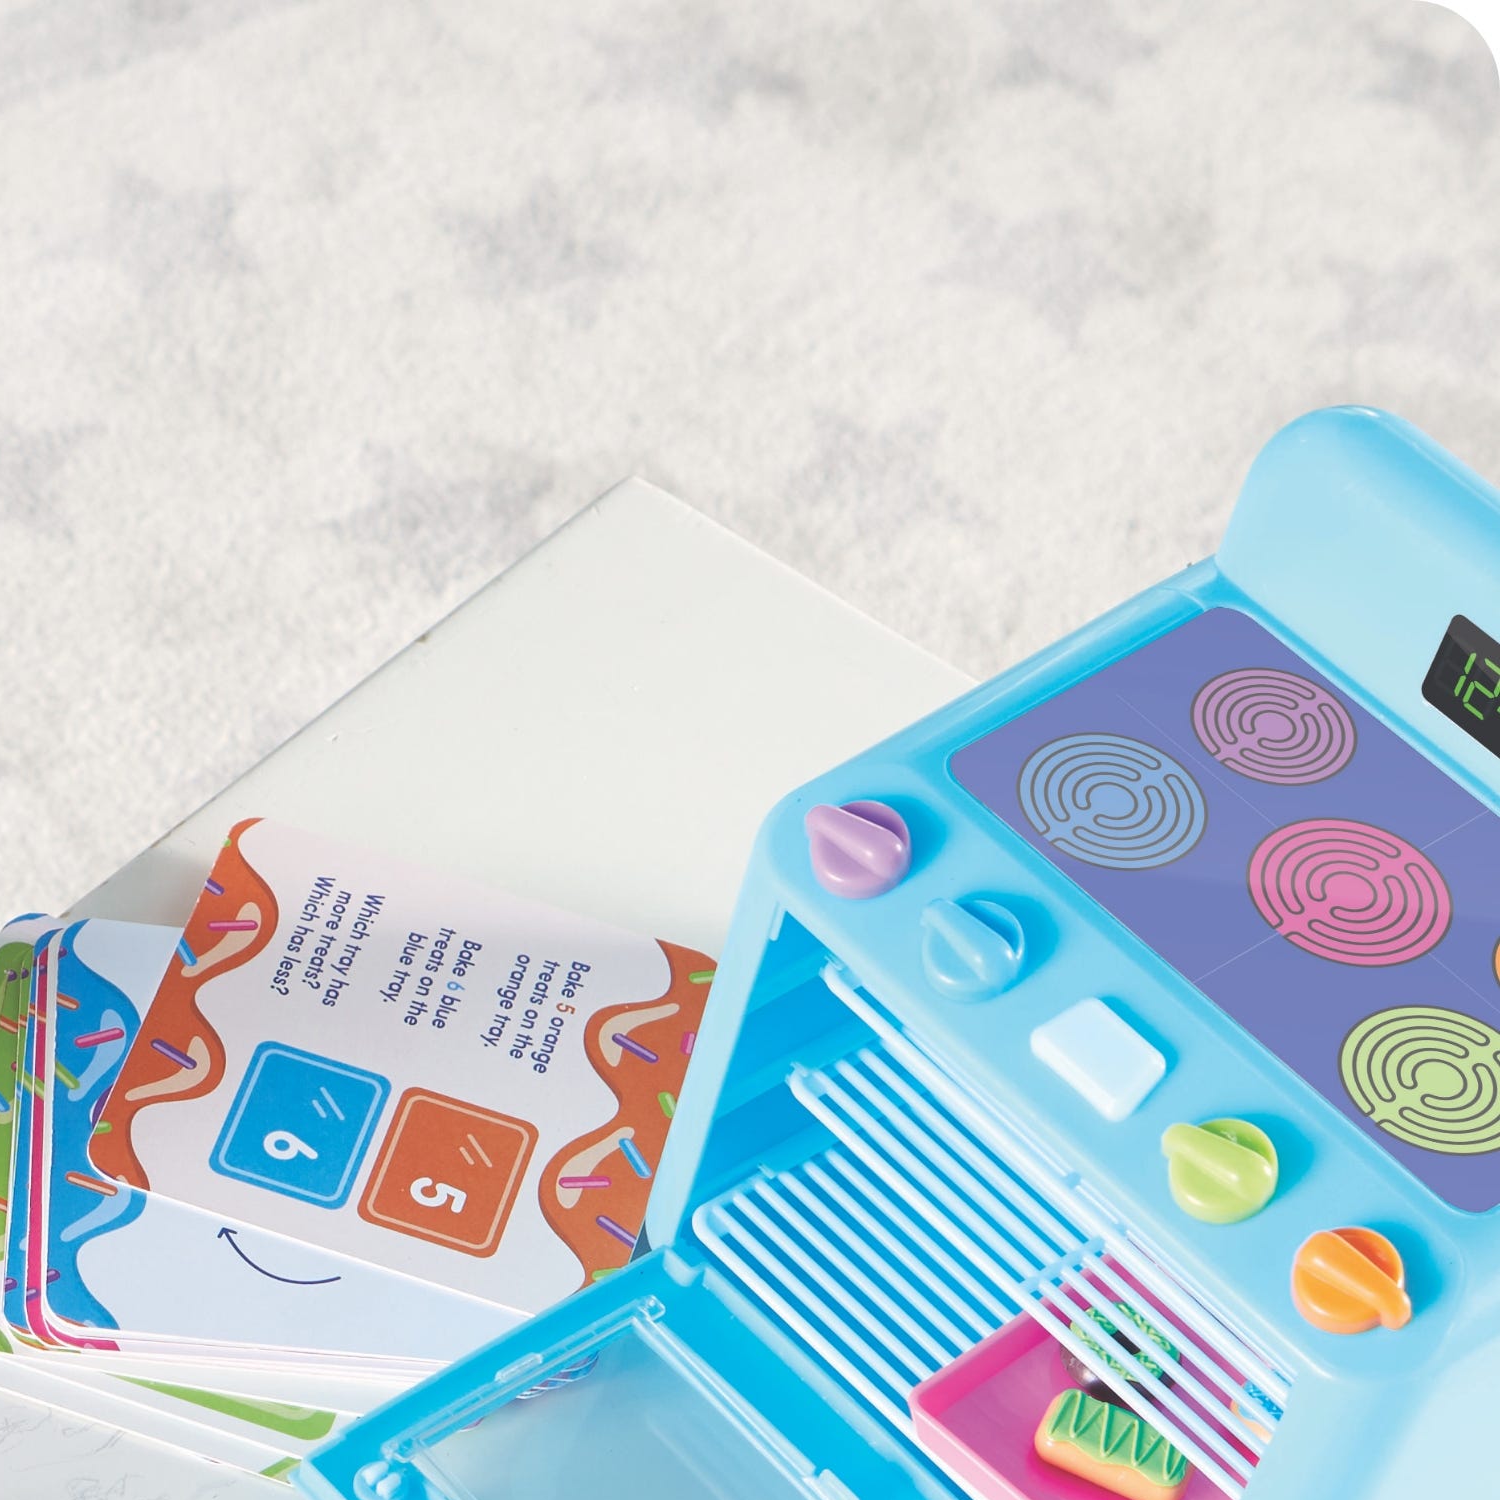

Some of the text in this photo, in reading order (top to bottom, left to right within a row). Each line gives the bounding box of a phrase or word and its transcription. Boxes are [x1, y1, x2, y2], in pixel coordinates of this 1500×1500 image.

[270, 876, 336, 996] Which has less?
[302, 890, 352, 990] more treats?
[322, 894, 386, 1007] Which tray has
[379, 932, 428, 1003] blue tray.
[404, 927, 457, 1026] treats on the
[432, 940, 483, 1029] Bake 6 blue
[480, 954, 530, 1048] orange tray.
[509, 959, 561, 1060] treats on the
[531, 961, 591, 1074] Bake 5 orange
[263, 1130, 318, 1161] 6
[410, 1176, 467, 1214] 5
